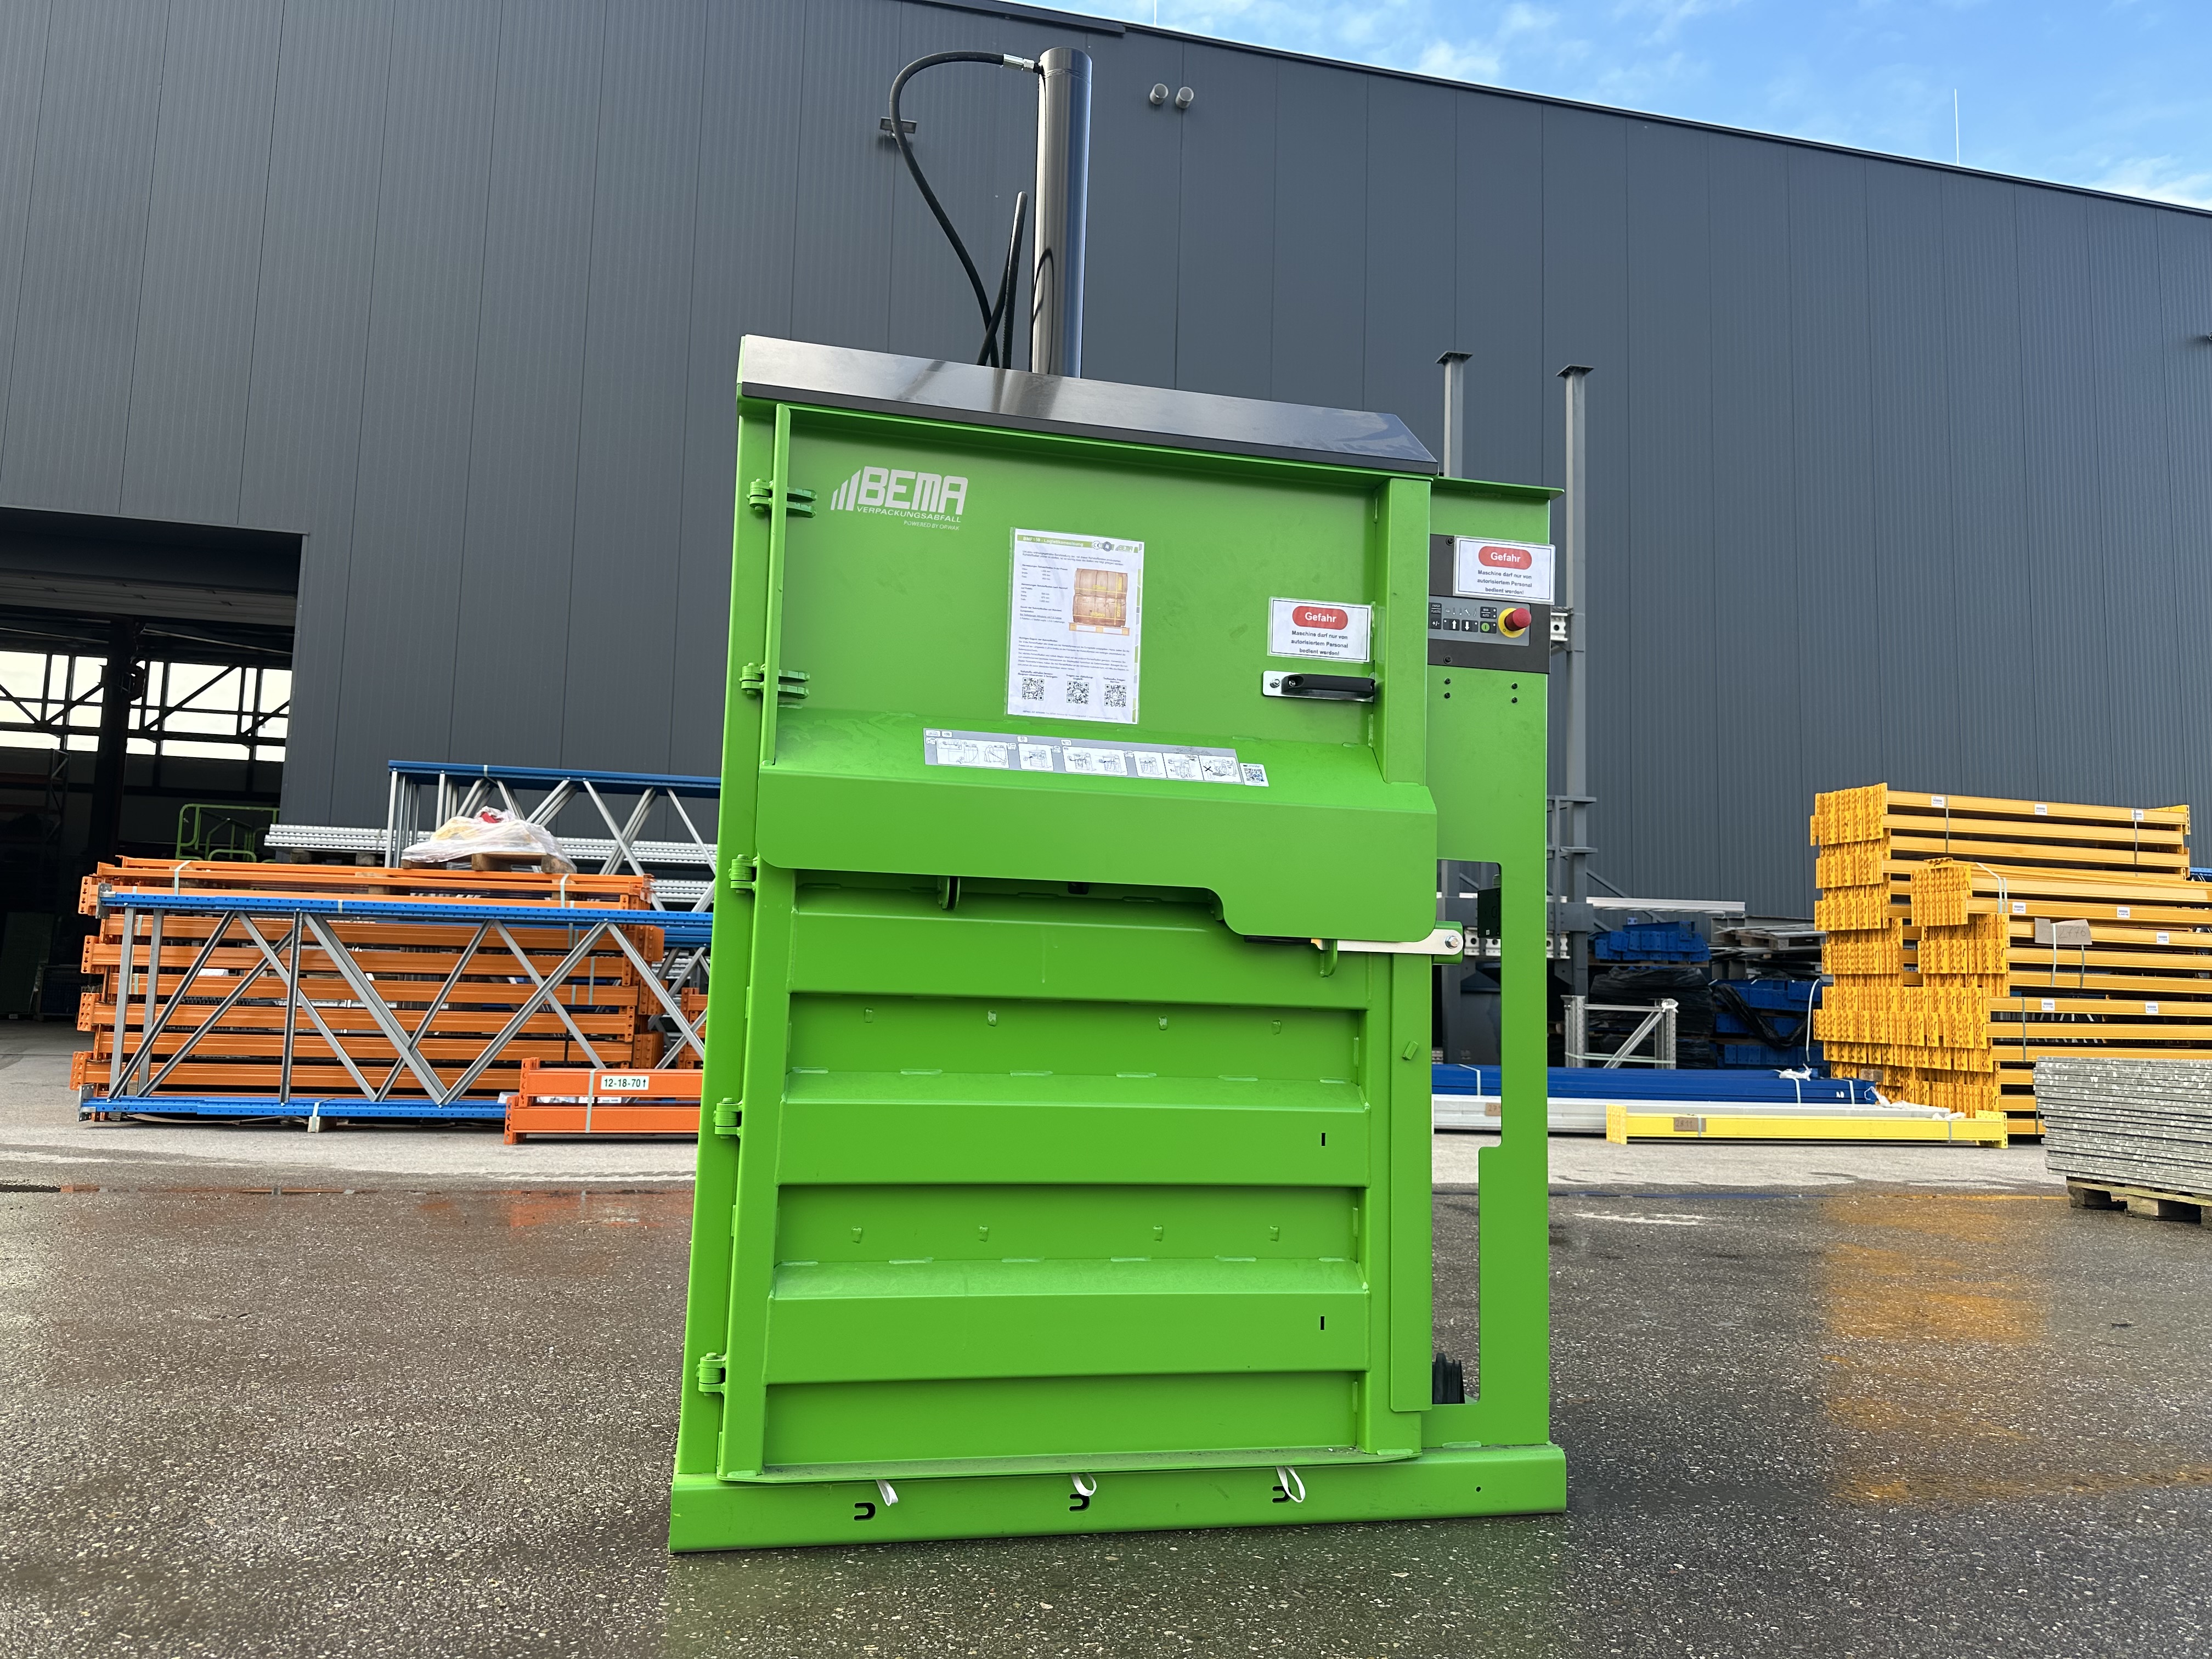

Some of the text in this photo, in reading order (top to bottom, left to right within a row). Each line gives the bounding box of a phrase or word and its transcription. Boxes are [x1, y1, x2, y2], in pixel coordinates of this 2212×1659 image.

[857, 466, 968, 515] BEMA
[857, 506, 961, 523] VERPACKUNGSABFALL
[1490, 552, 1521, 563] Gefahr
[1305, 612, 1337, 623] Gefahr
[2058, 926, 2086, 939] 2776
[604, 1078, 641, 1087] 12-18-70
